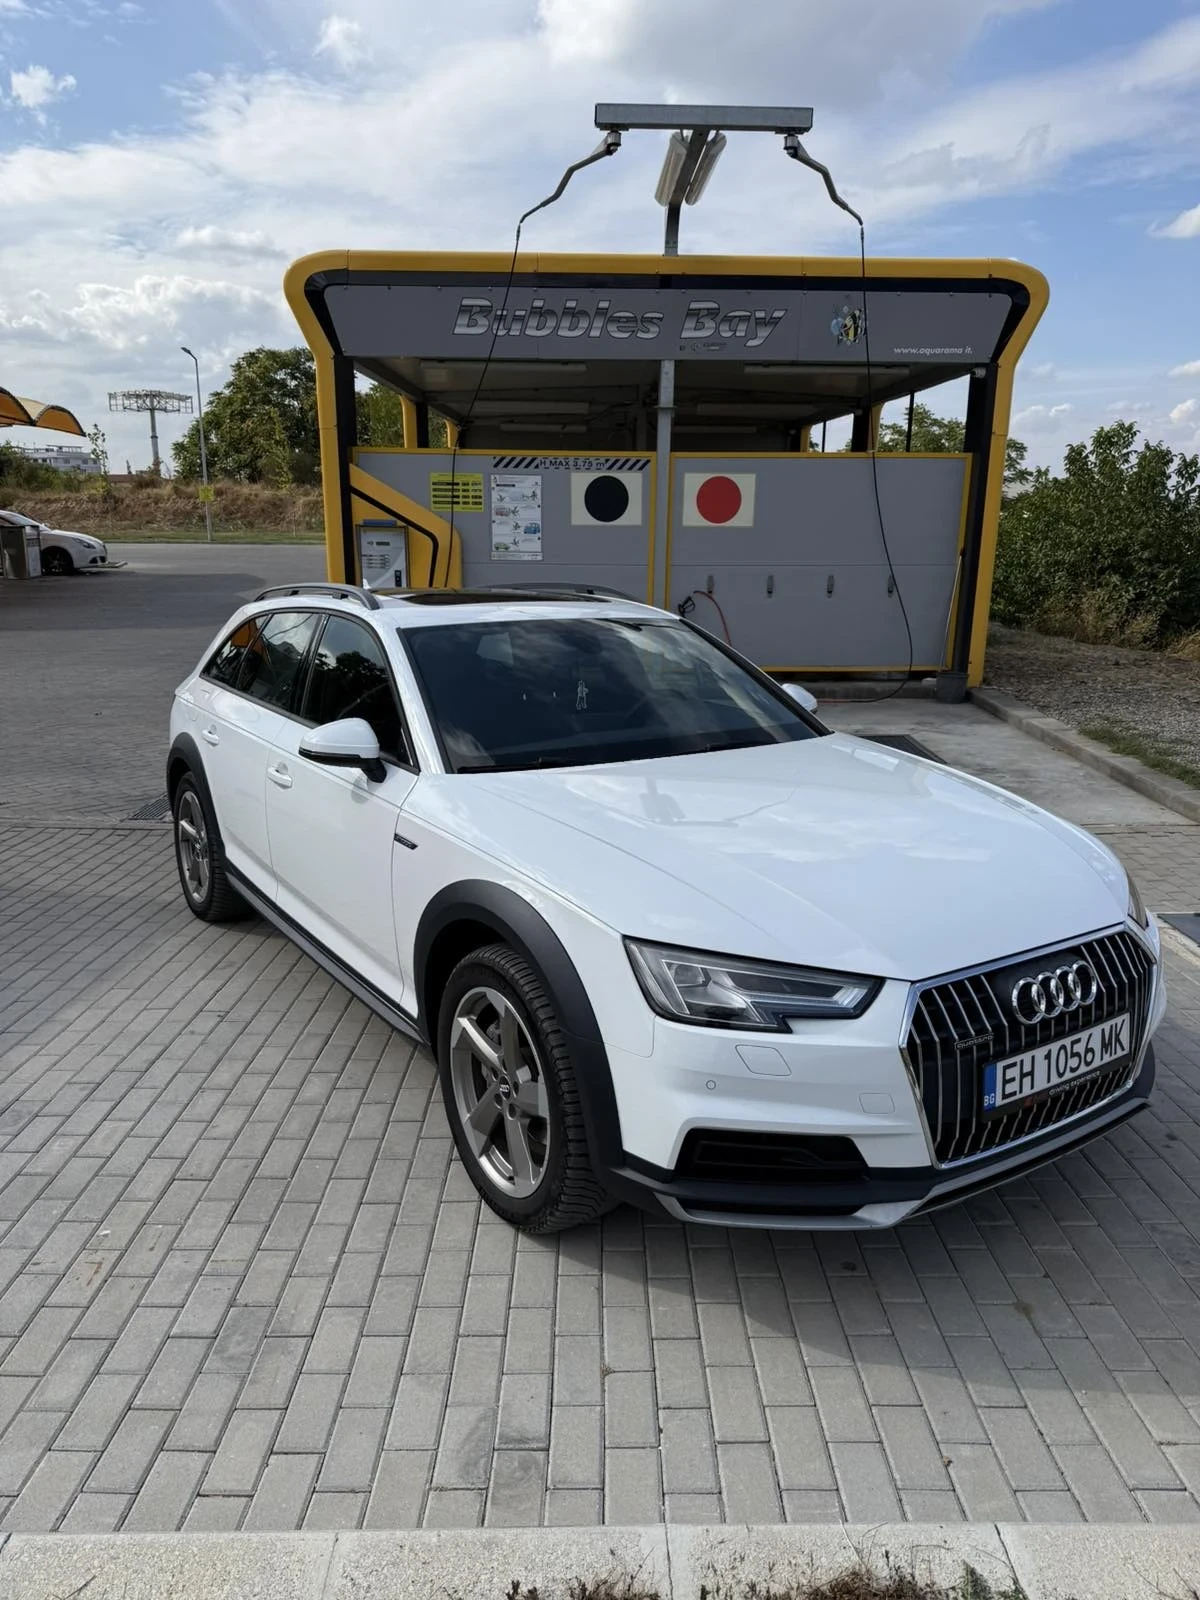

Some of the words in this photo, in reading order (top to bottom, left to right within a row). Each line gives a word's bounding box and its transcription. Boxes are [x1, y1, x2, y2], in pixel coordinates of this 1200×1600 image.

[452, 297, 664, 340] Bubbles
[680, 300, 788, 347] Bay
[549, 459, 570, 467] MAX
[1001, 1055, 1035, 1100] EH
[1044, 1032, 1096, 1084] 1056
[1101, 1018, 1126, 1062] MK
[983, 1092, 995, 1107] BG
